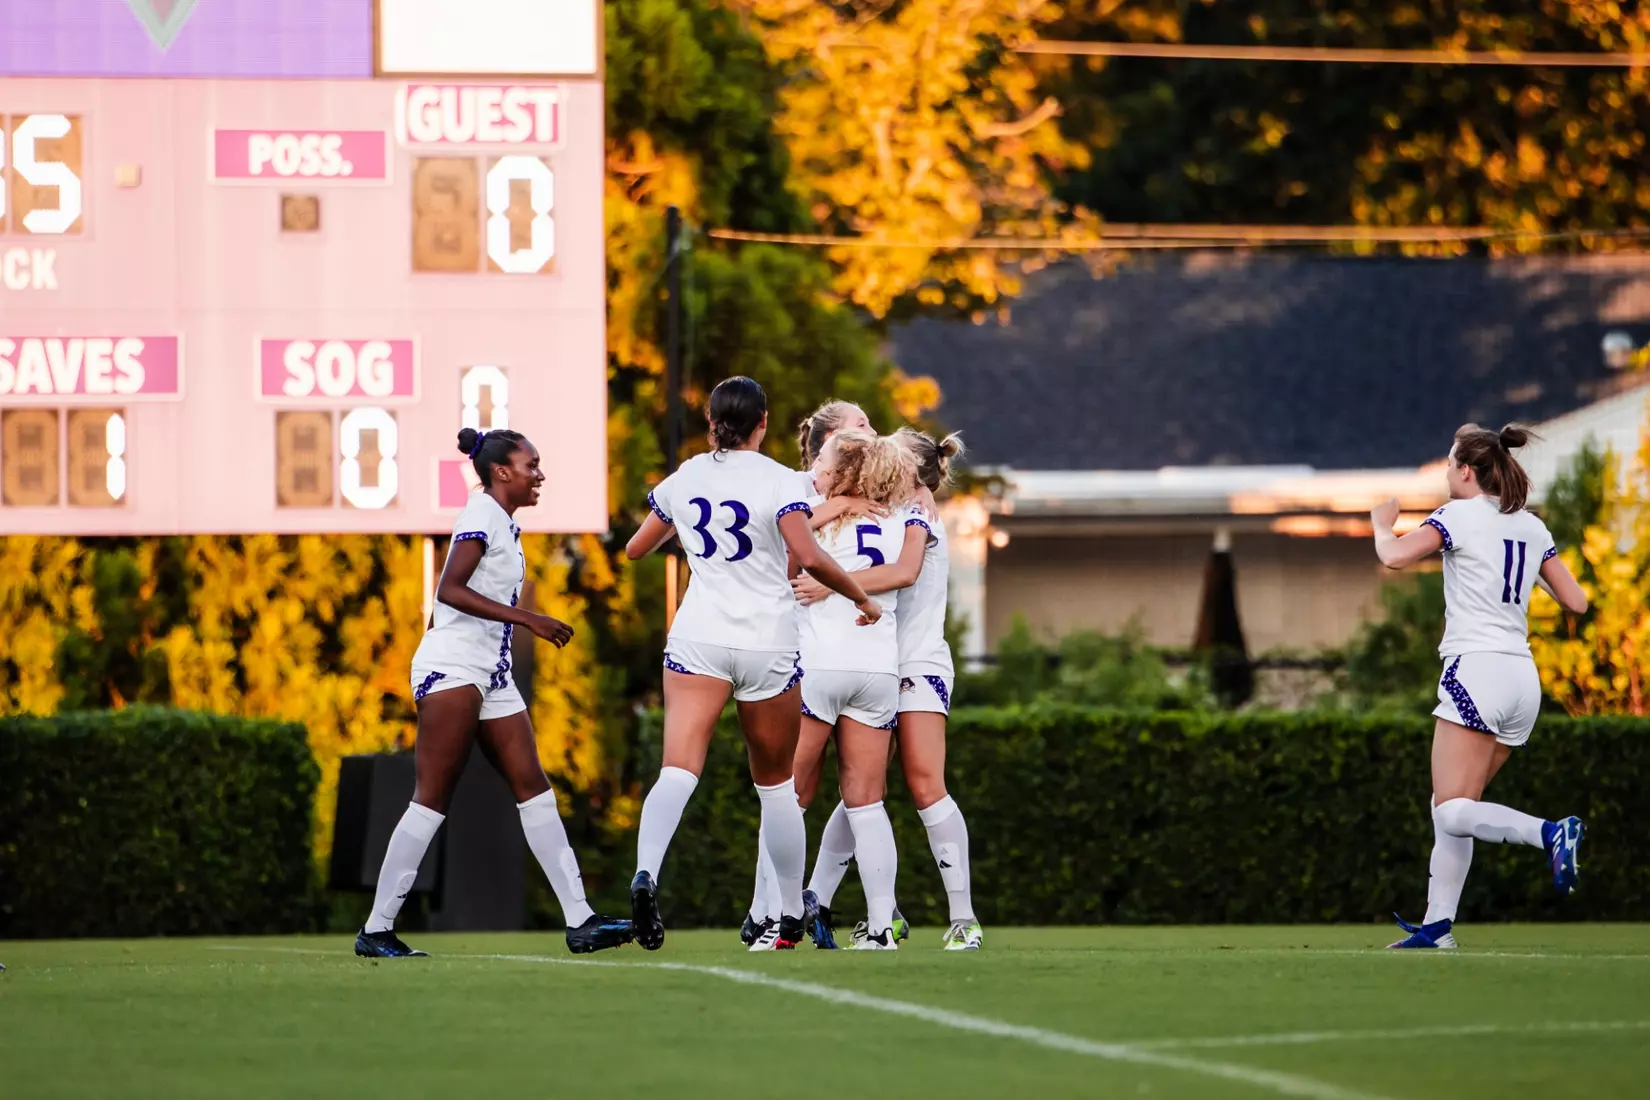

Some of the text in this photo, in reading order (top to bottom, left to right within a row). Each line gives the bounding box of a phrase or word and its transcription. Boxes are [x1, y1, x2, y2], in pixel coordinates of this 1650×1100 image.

[408, 85, 560, 142] GUEST
[0, 114, 82, 233] 5
[248, 132, 354, 176] POSS.
[487, 155, 554, 274] 0
[0, 247, 58, 290] CK
[282, 340, 395, 397] SOG
[106, 412, 126, 500] 1
[340, 406, 398, 509] 0
[689, 497, 753, 562] 33
[856, 524, 885, 568] 5
[1502, 538, 1526, 604] 11
